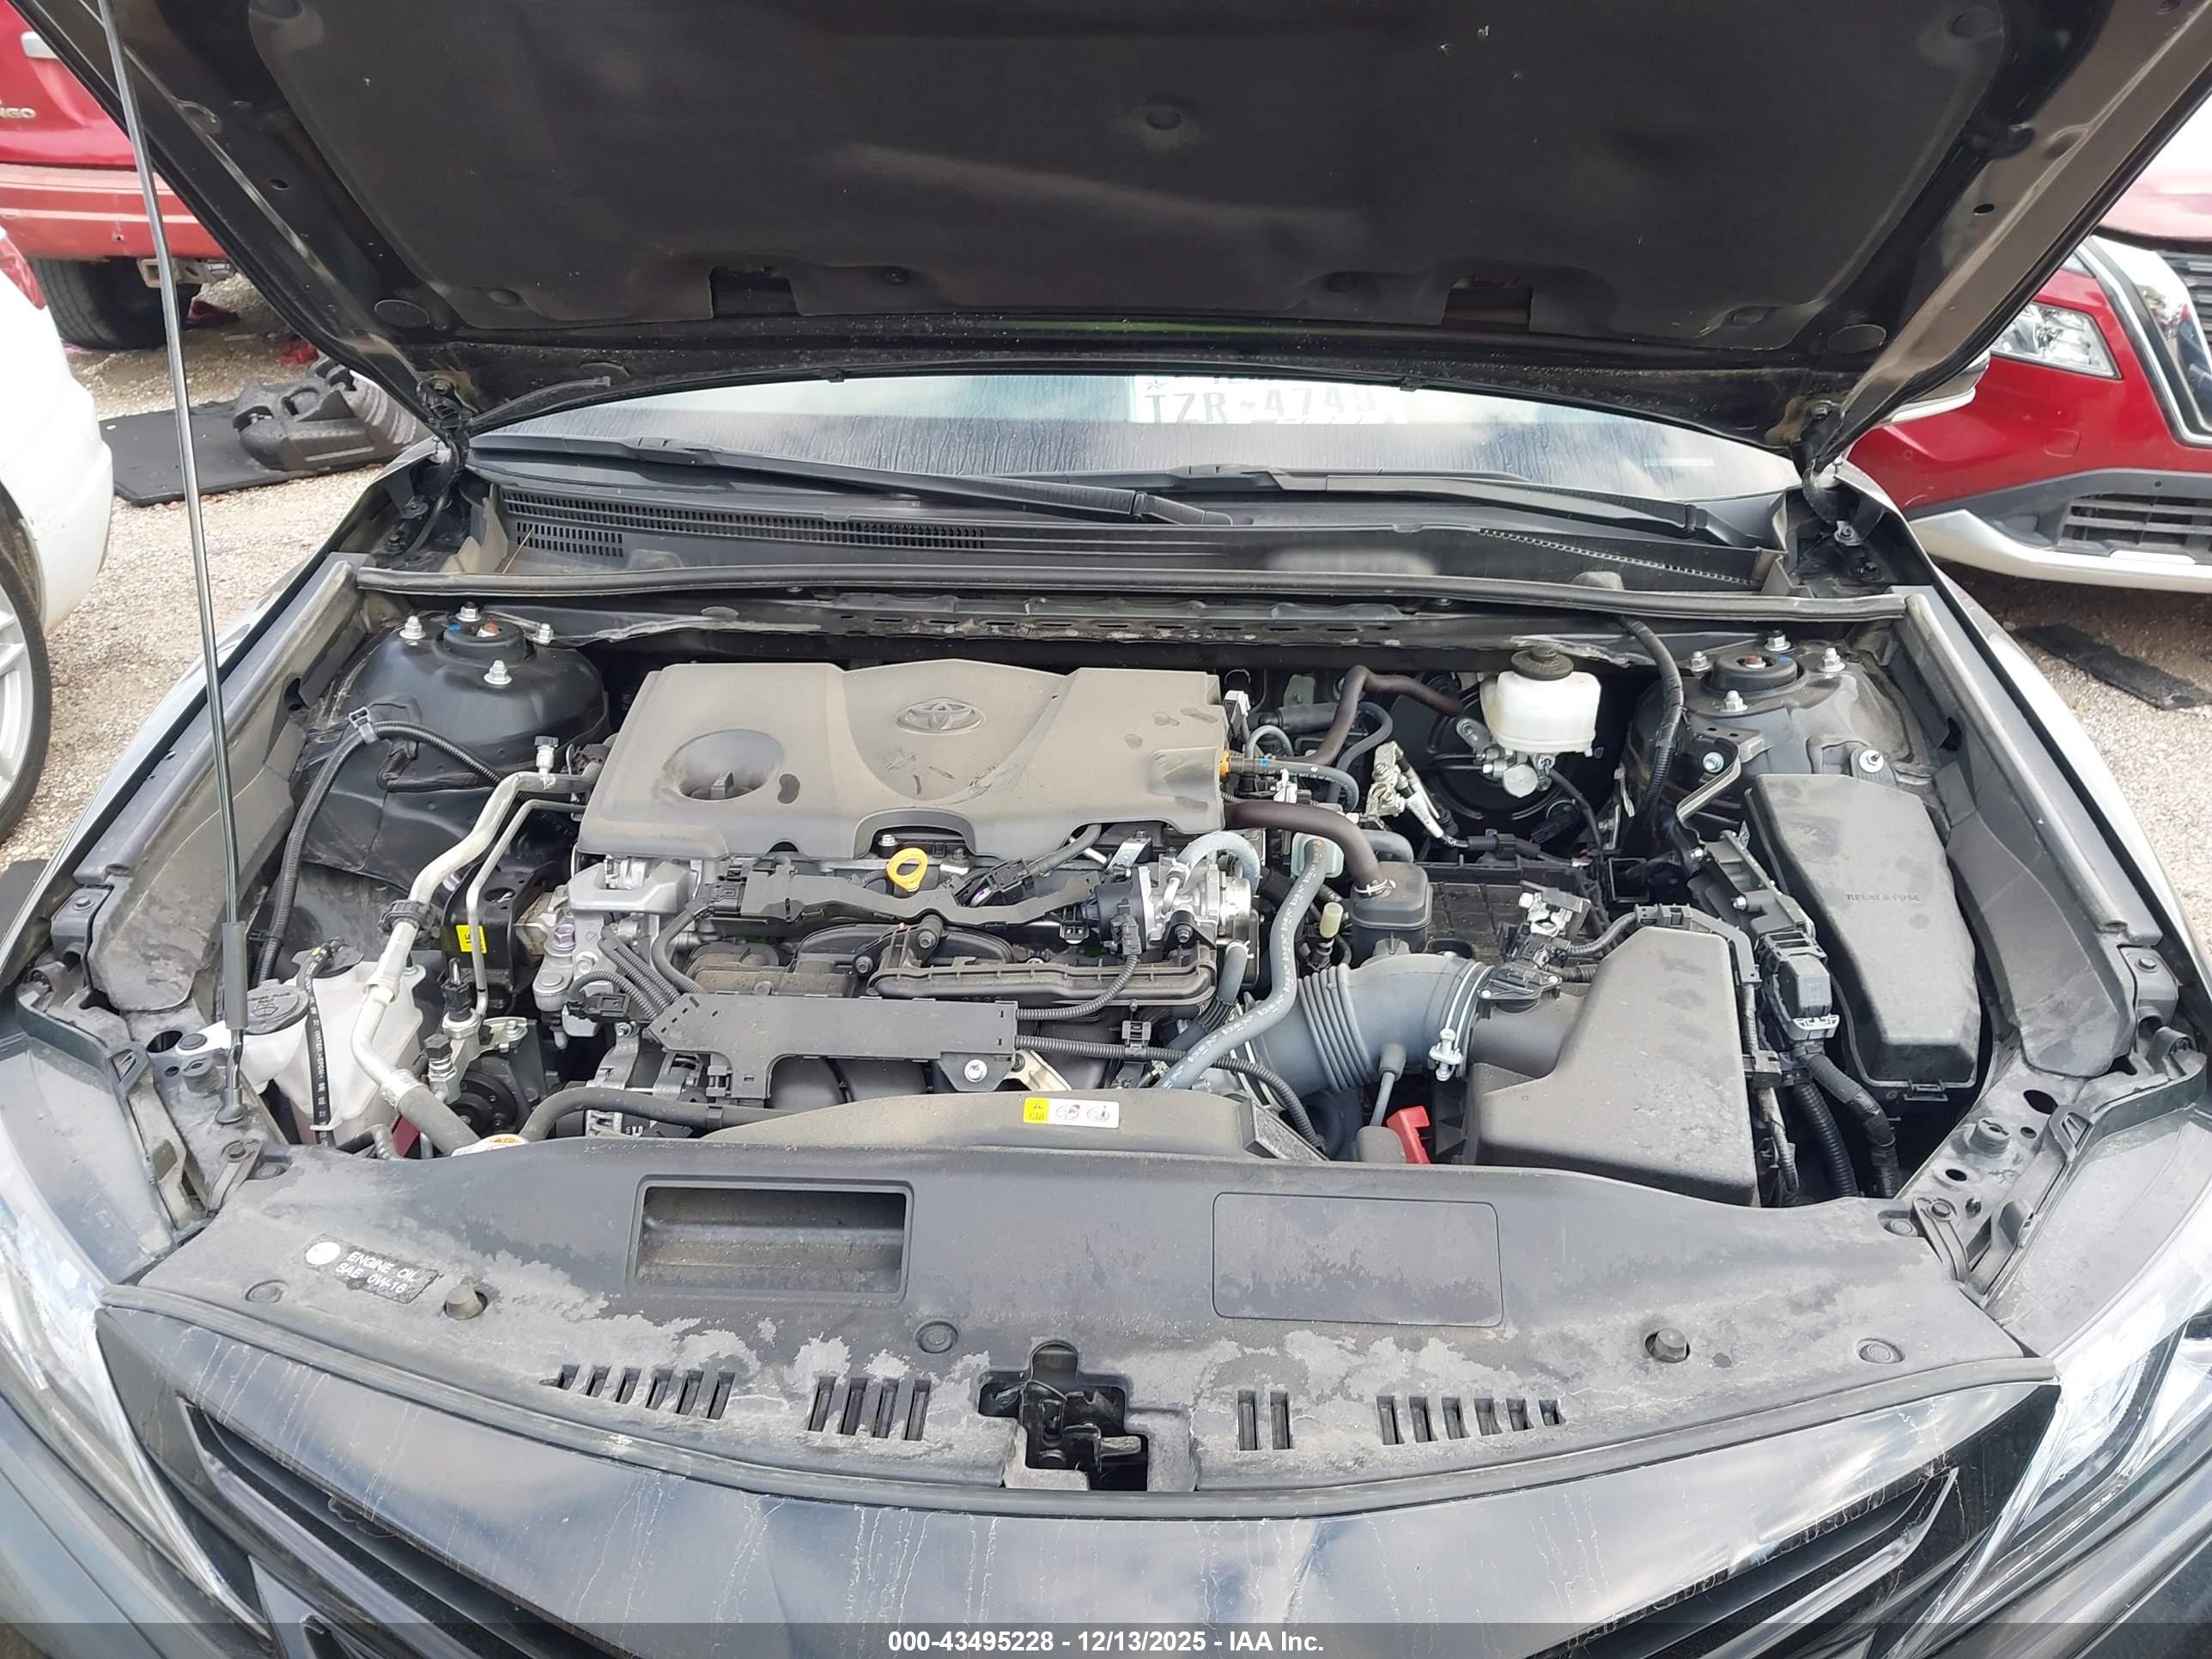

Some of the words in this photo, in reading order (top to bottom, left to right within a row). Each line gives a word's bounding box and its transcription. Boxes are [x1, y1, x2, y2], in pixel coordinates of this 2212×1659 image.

[1845, 893, 1881, 902] RELAY
[335, 1262, 365, 1279] SAE
[367, 1273, 408, 1293] 0W-16
[346, 1251, 395, 1273] ENGINE
[397, 1267, 418, 1282] OIL
